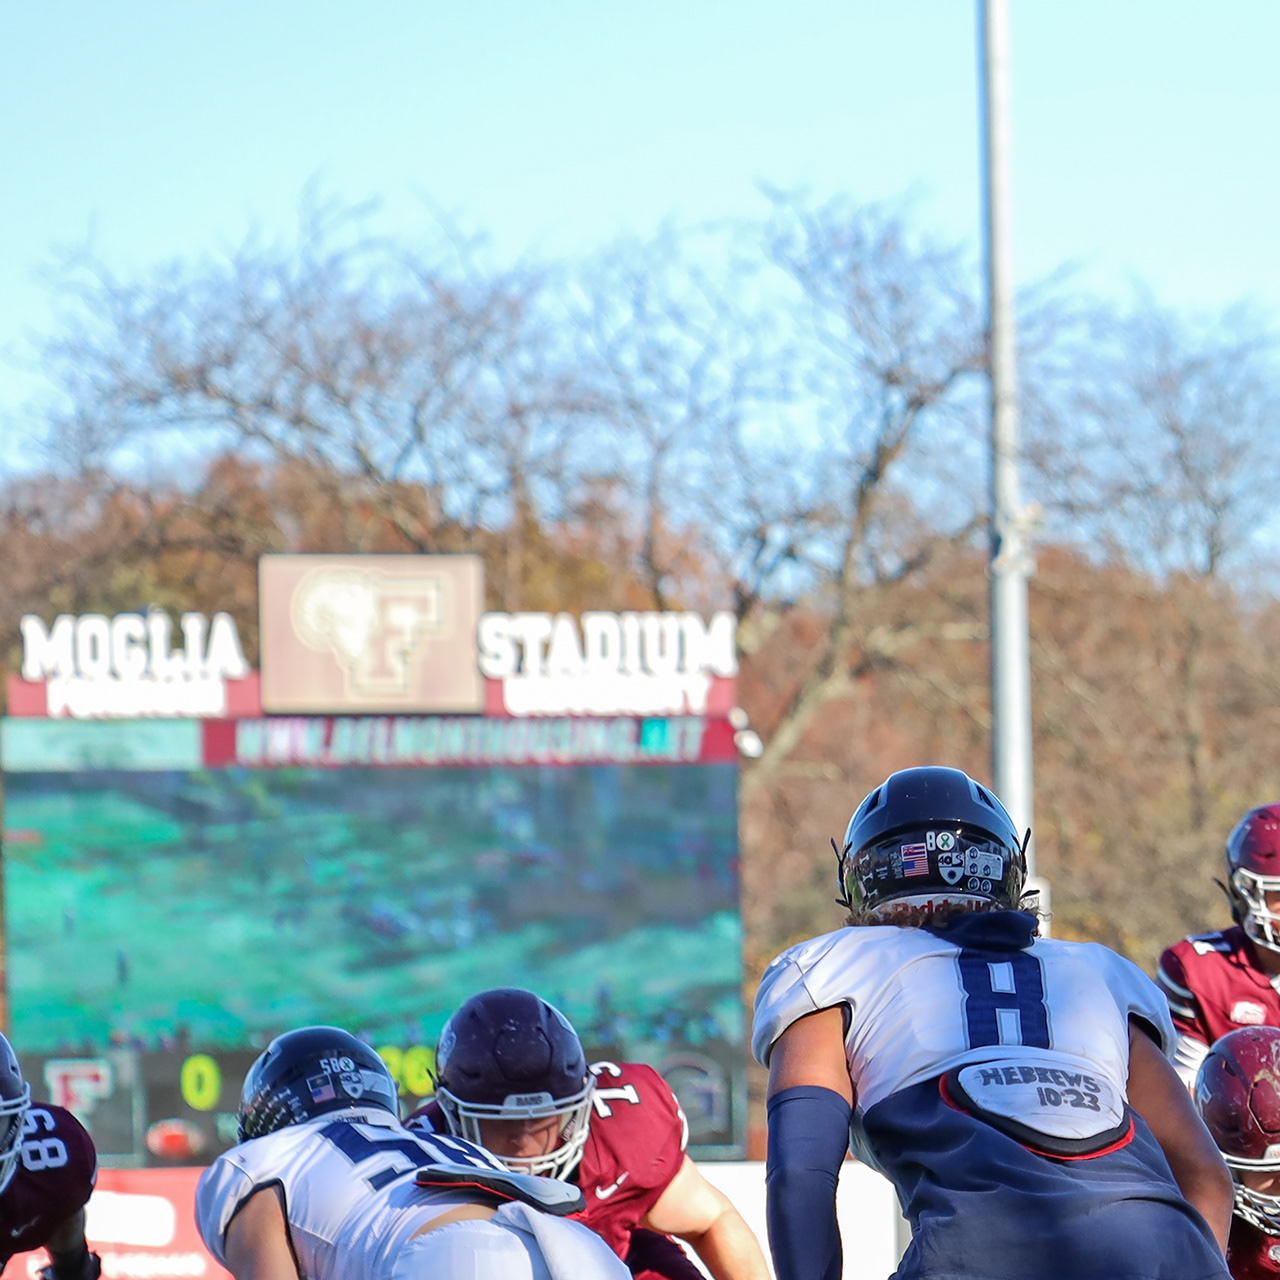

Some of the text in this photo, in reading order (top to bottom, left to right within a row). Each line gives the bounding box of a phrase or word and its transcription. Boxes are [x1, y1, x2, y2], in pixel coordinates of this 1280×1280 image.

[20, 610, 739, 682] MOGLIA STADIUM
[181, 1053, 222, 1111] 0
[981, 1066, 1102, 1094] HEBREWS
[1037, 1086, 1102, 1113] 10:23
